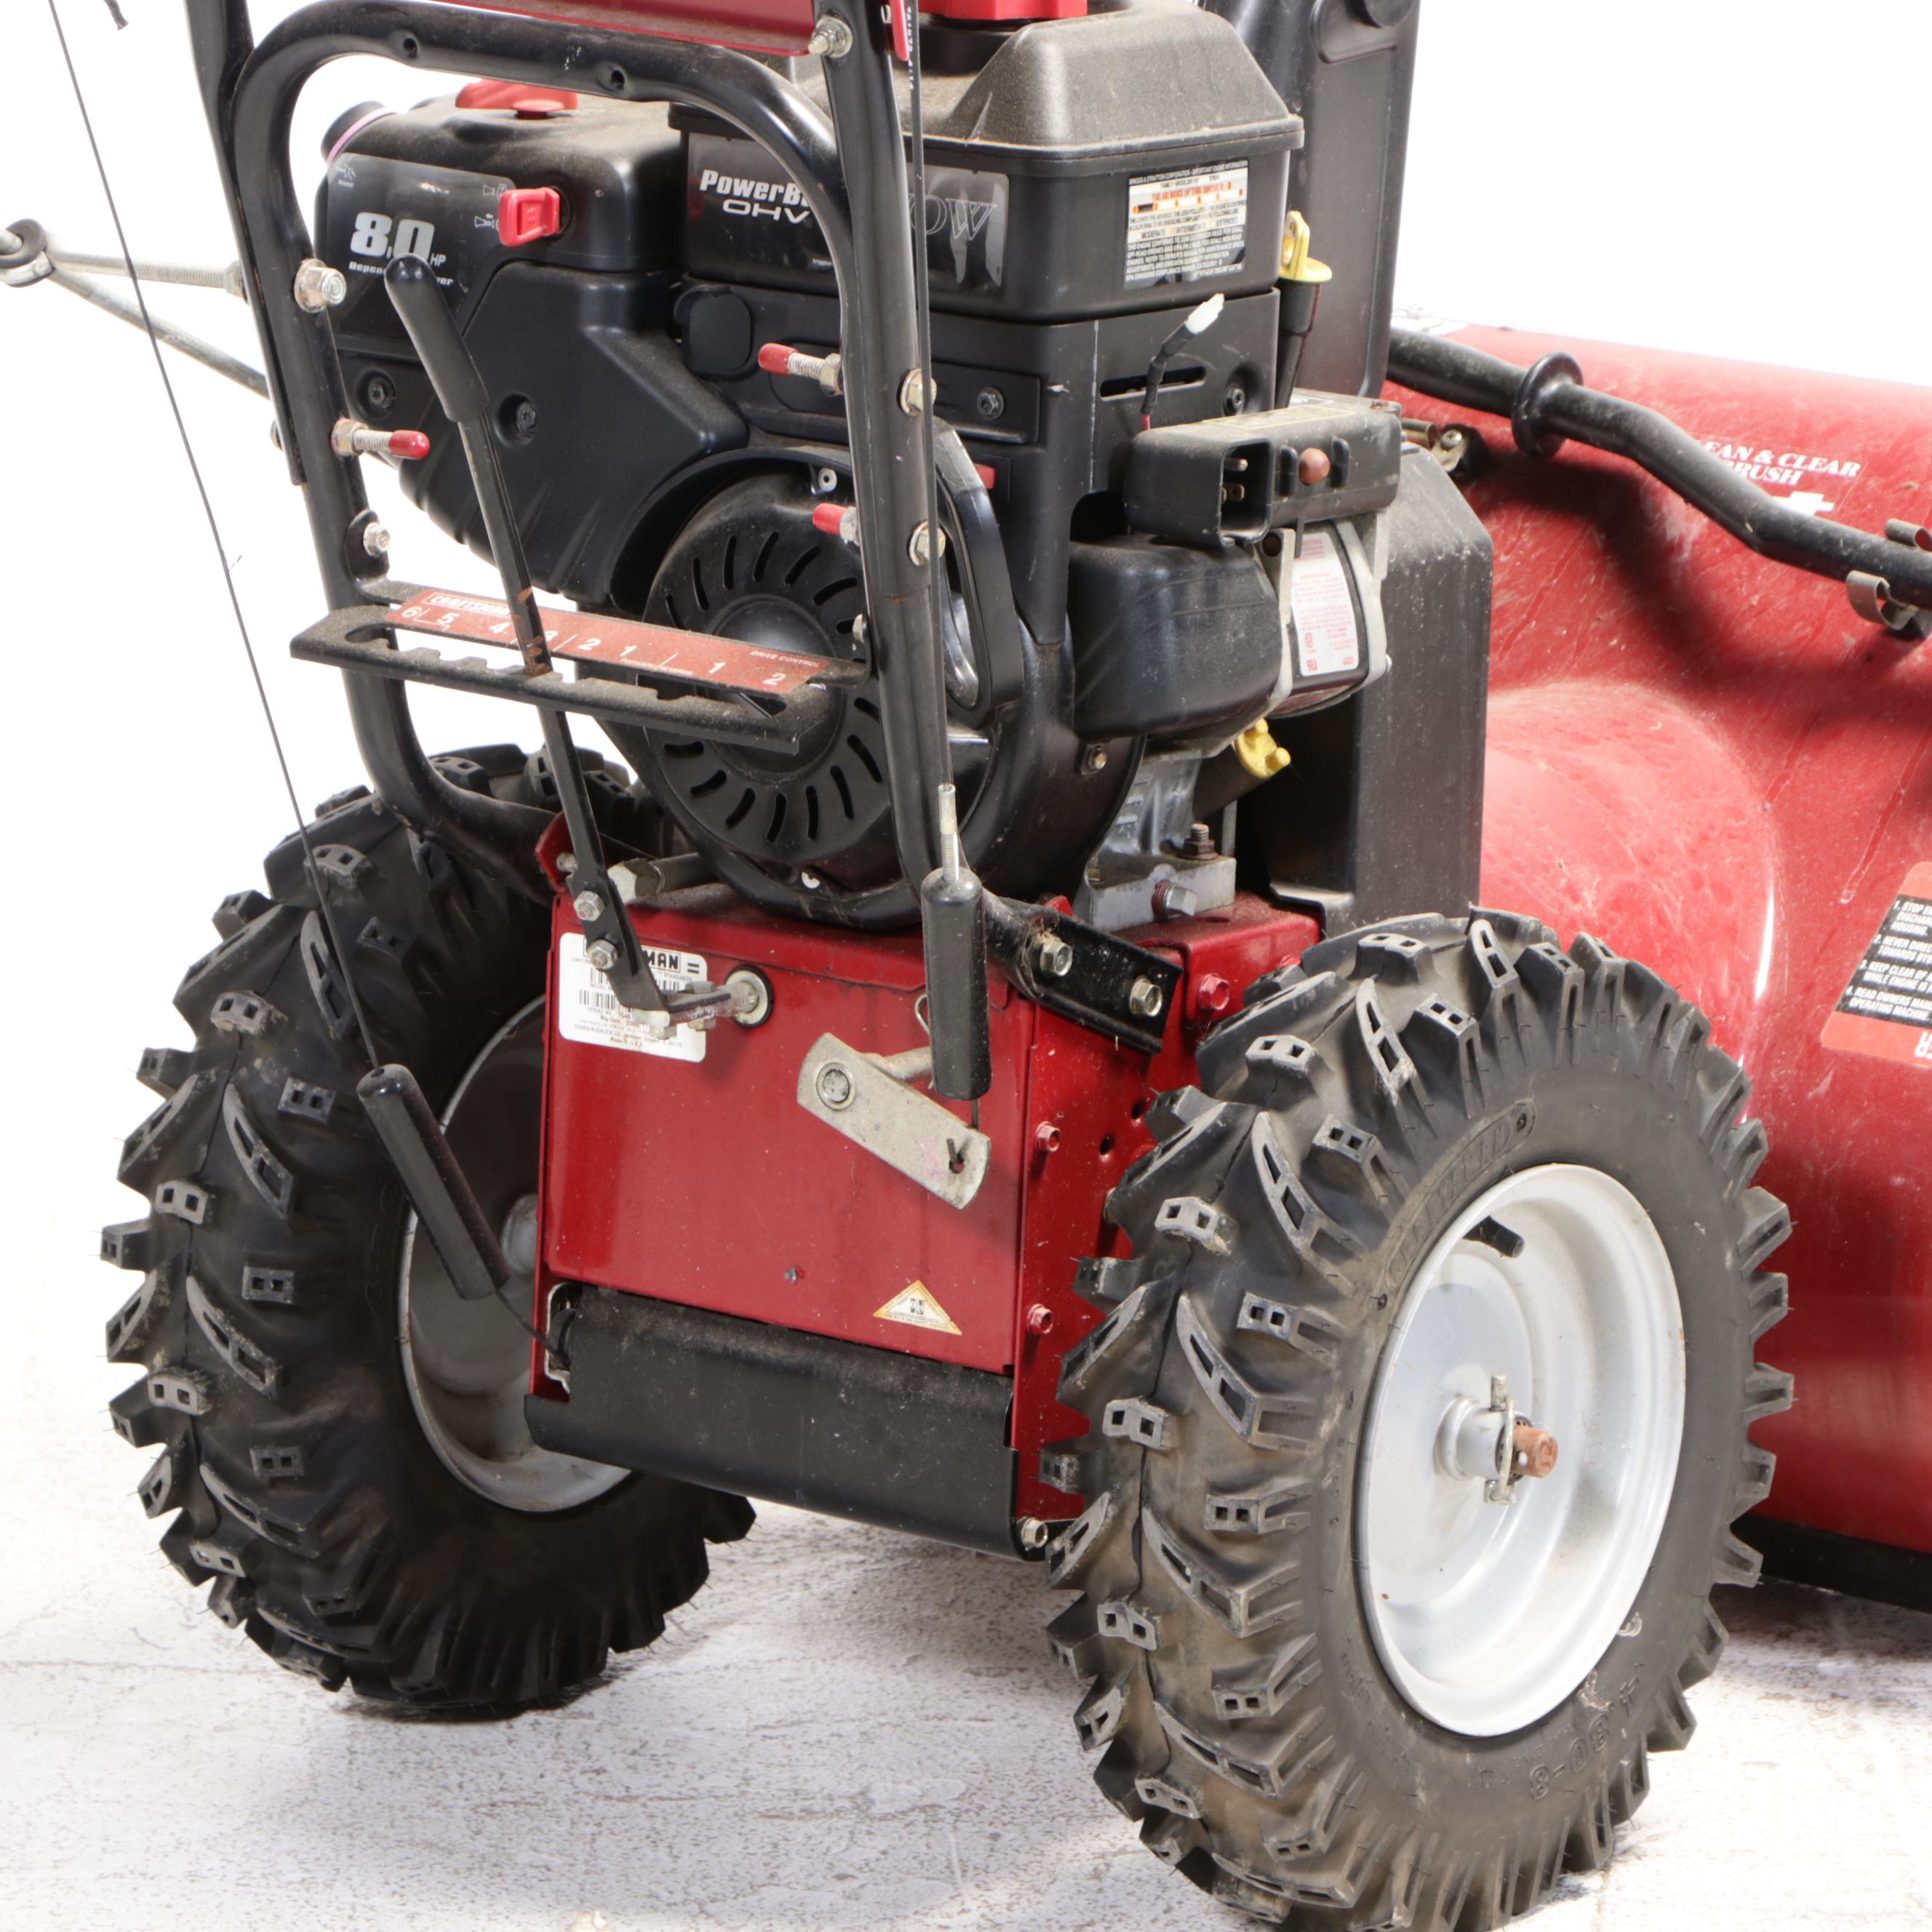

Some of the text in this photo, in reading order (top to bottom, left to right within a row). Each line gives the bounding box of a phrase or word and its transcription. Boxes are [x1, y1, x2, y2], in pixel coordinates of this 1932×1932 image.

[722, 199, 810, 223] OHV
[351, 212, 447, 267] 8.0 HP
[349, 261, 384, 275] Depen
[1705, 442, 1861, 477] EAN & CLEAR
[402, 606, 423, 618] 6
[436, 612, 460, 624] 5
[489, 622, 511, 634] 4
[578, 638, 601, 650] 2
[620, 645, 637, 657] 1
[708, 661, 726, 674] 1
[763, 672, 786, 686] 2
[751, 650, 820, 668] DRIVE CONTROL
[1893, 901, 1900, 910] 1.
[1901, 902, 1925, 913] STOP
[1891, 920, 1928, 936] HOUSING.
[1874, 934, 1882, 943] 2.
[1882, 935, 1910, 948] NEVER
[1877, 945, 1918, 961] TOWARDS
[1859, 959, 1868, 970] 3.
[1868, 961, 1891, 973] KEEP
[1888, 965, 1916, 978] CLEAR
[1914, 970, 1928, 981] OF
[1863, 970, 1891, 984] WHILE
[1888, 975, 1920, 991] ENGINE
[1917, 981, 1929, 991] IS
[1854, 986, 1877, 999] READ
[1848, 997, 1930, 1021] OPERATING MACHINE.
